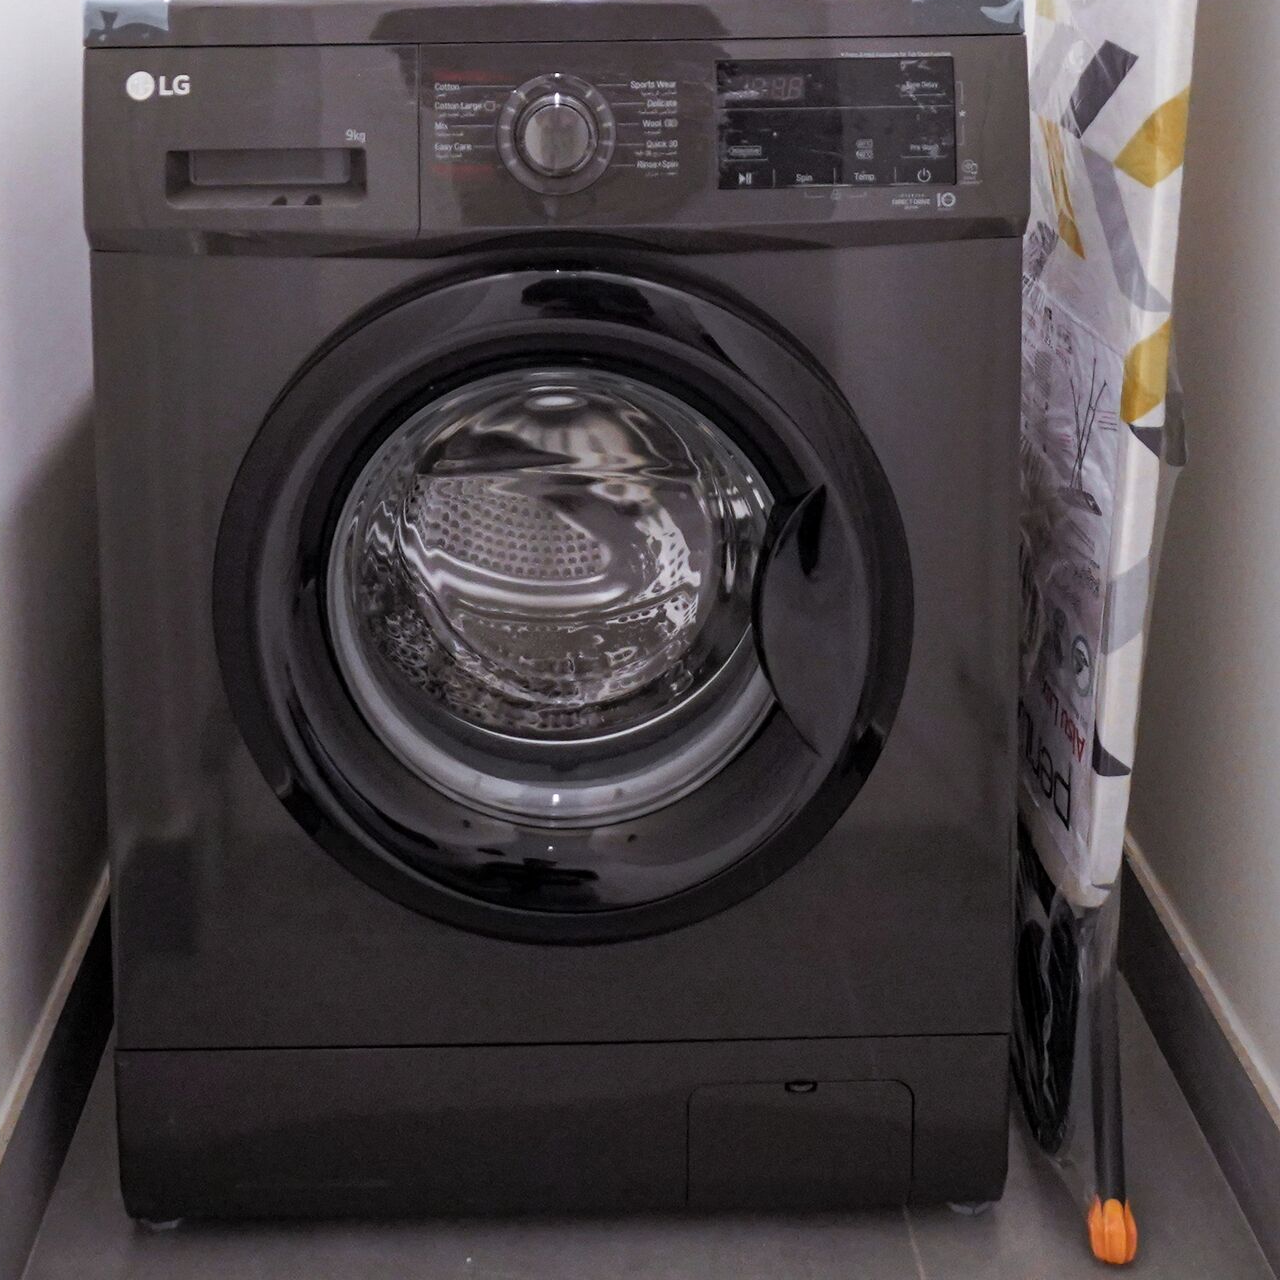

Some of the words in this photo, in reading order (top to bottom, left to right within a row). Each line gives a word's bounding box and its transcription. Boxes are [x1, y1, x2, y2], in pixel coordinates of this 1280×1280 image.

[159, 75, 190, 96] LG
[434, 82, 460, 91] Cotton
[630, 80, 655, 90] Sports
[656, 80, 676, 88] Wear
[434, 102, 459, 111] Cotton
[642, 120, 662, 128] Wool
[345, 129, 367, 143] 9kg
[434, 143, 453, 151] Easy
[796, 173, 814, 182] Spin
